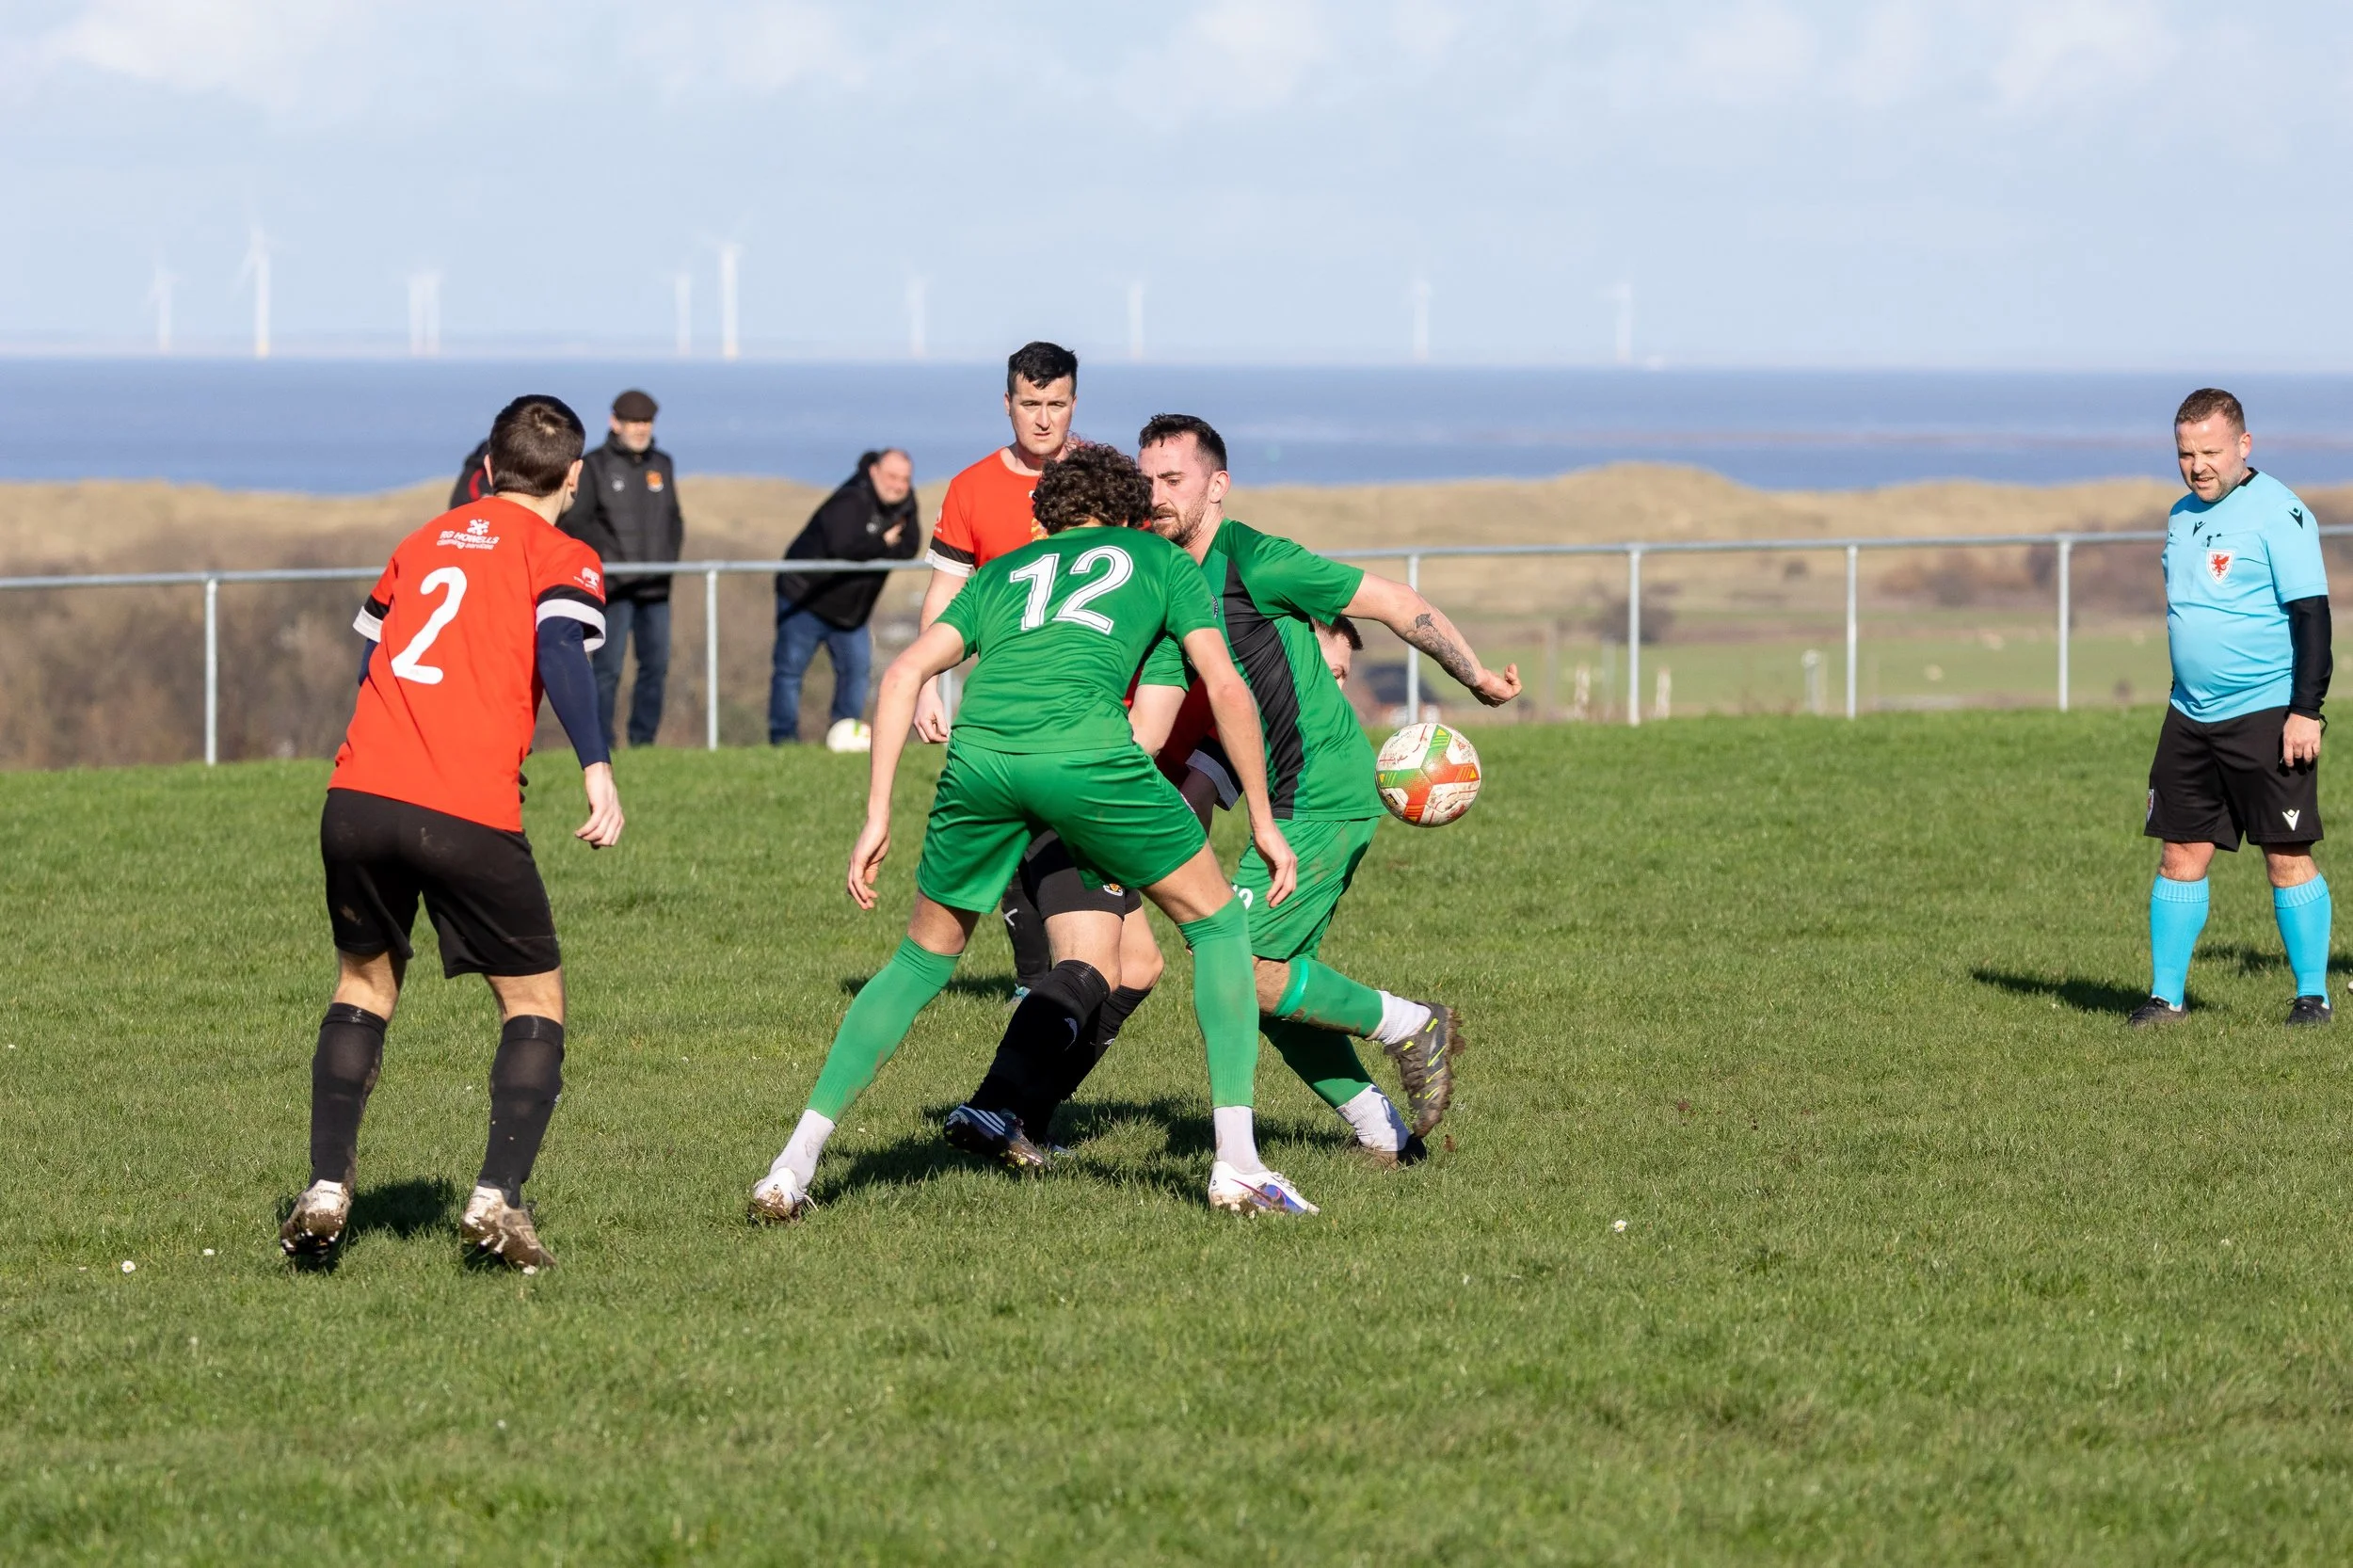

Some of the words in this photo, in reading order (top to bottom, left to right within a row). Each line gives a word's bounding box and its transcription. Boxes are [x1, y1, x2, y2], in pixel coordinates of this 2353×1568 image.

[453, 532, 500, 544] HOWELLS
[391, 566, 468, 684] 2
[1009, 545, 1134, 635] 12
